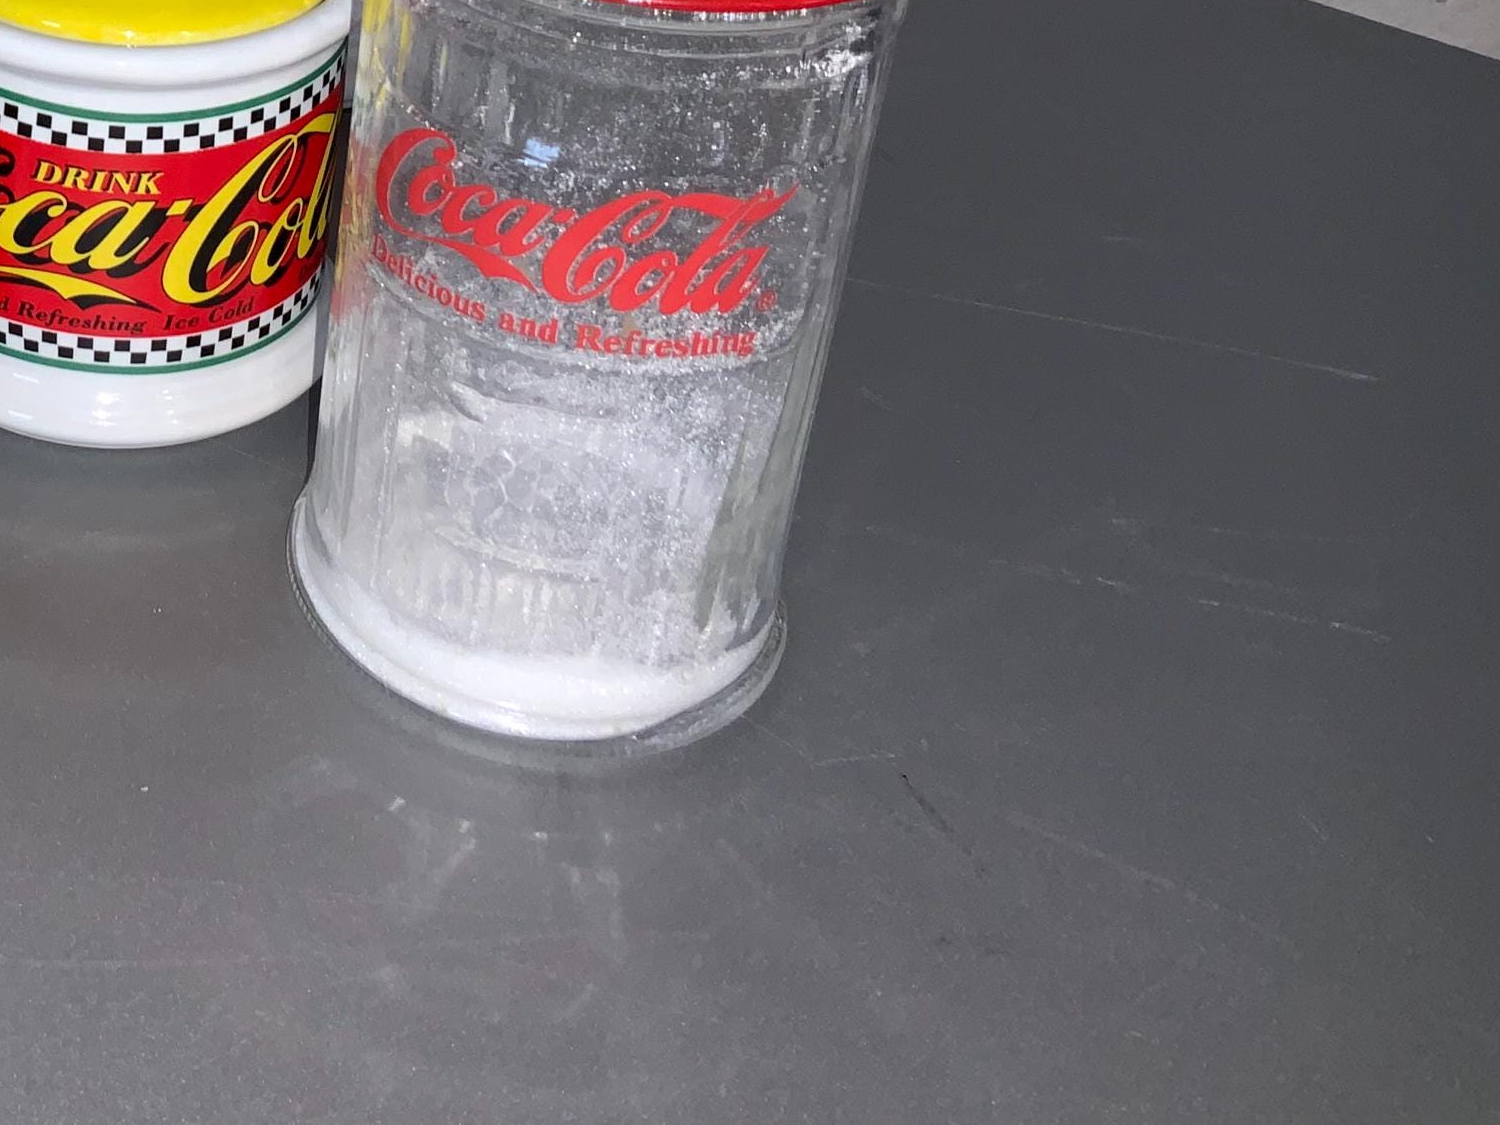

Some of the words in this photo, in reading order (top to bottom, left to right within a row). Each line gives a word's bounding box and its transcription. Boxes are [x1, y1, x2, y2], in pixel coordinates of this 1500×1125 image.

[34, 159, 165, 196] DRINK
[375, 127, 800, 316] Coca-Cola
[17, 300, 148, 336] Refreshing
[162, 313, 202, 332] Ice
[208, 297, 257, 325] Cold
[370, 234, 486, 322] Delicious
[500, 312, 558, 344] and
[575, 323, 757, 358] Refreshing
